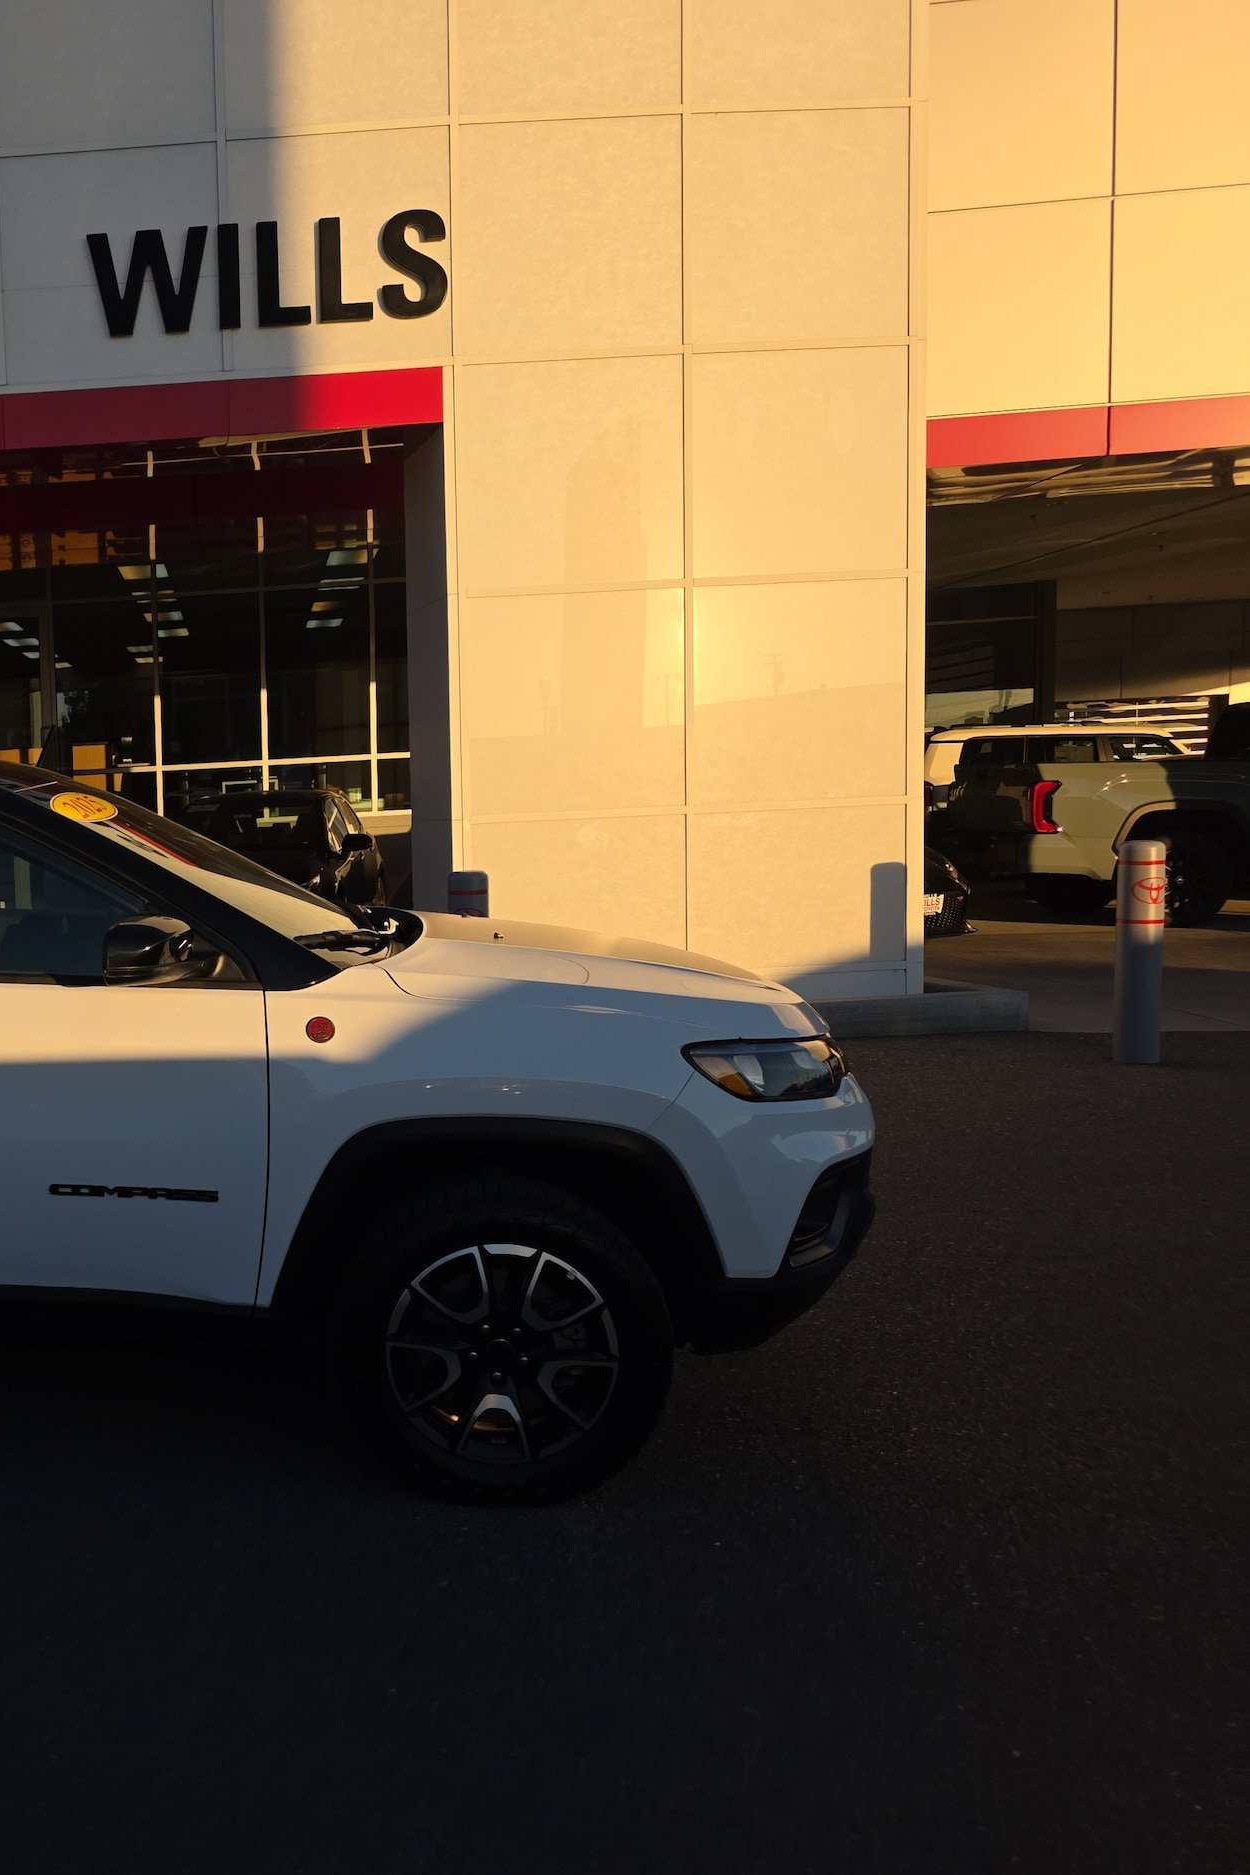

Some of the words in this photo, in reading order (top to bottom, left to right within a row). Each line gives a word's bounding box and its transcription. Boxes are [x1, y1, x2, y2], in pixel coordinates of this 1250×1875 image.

[86, 209, 448, 337] WILLS
[62, 796, 107, 819] 2025
[49, 1183, 219, 1203] COMPASS
